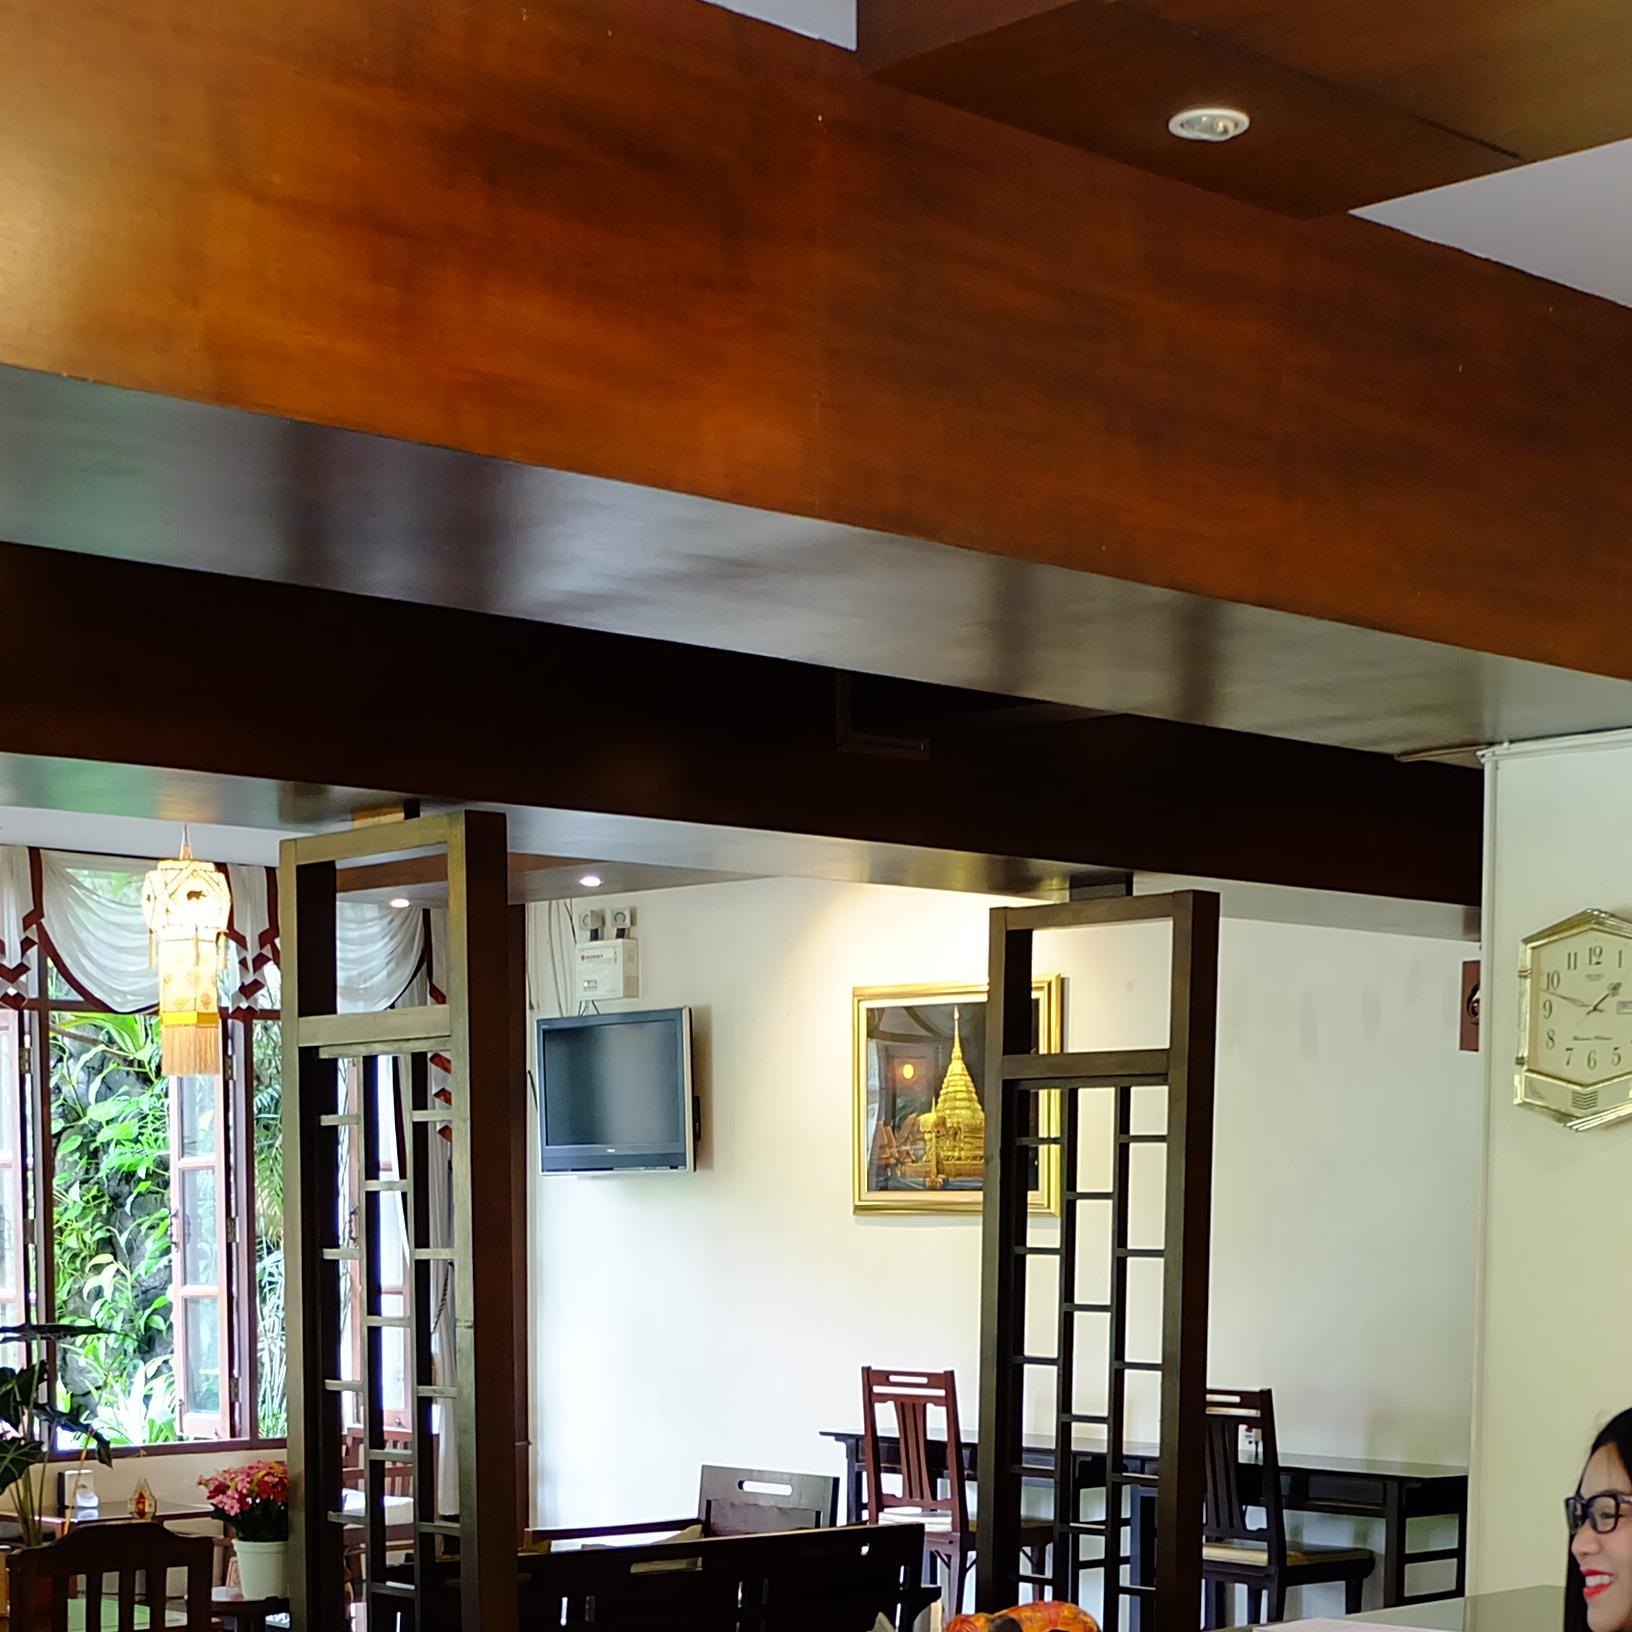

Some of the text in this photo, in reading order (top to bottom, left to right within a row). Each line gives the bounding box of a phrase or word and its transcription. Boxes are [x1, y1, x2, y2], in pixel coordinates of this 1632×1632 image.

[1567, 951, 1578, 971] 11
[1588, 945, 1603, 965] 12
[1546, 971, 1560, 990] 10
